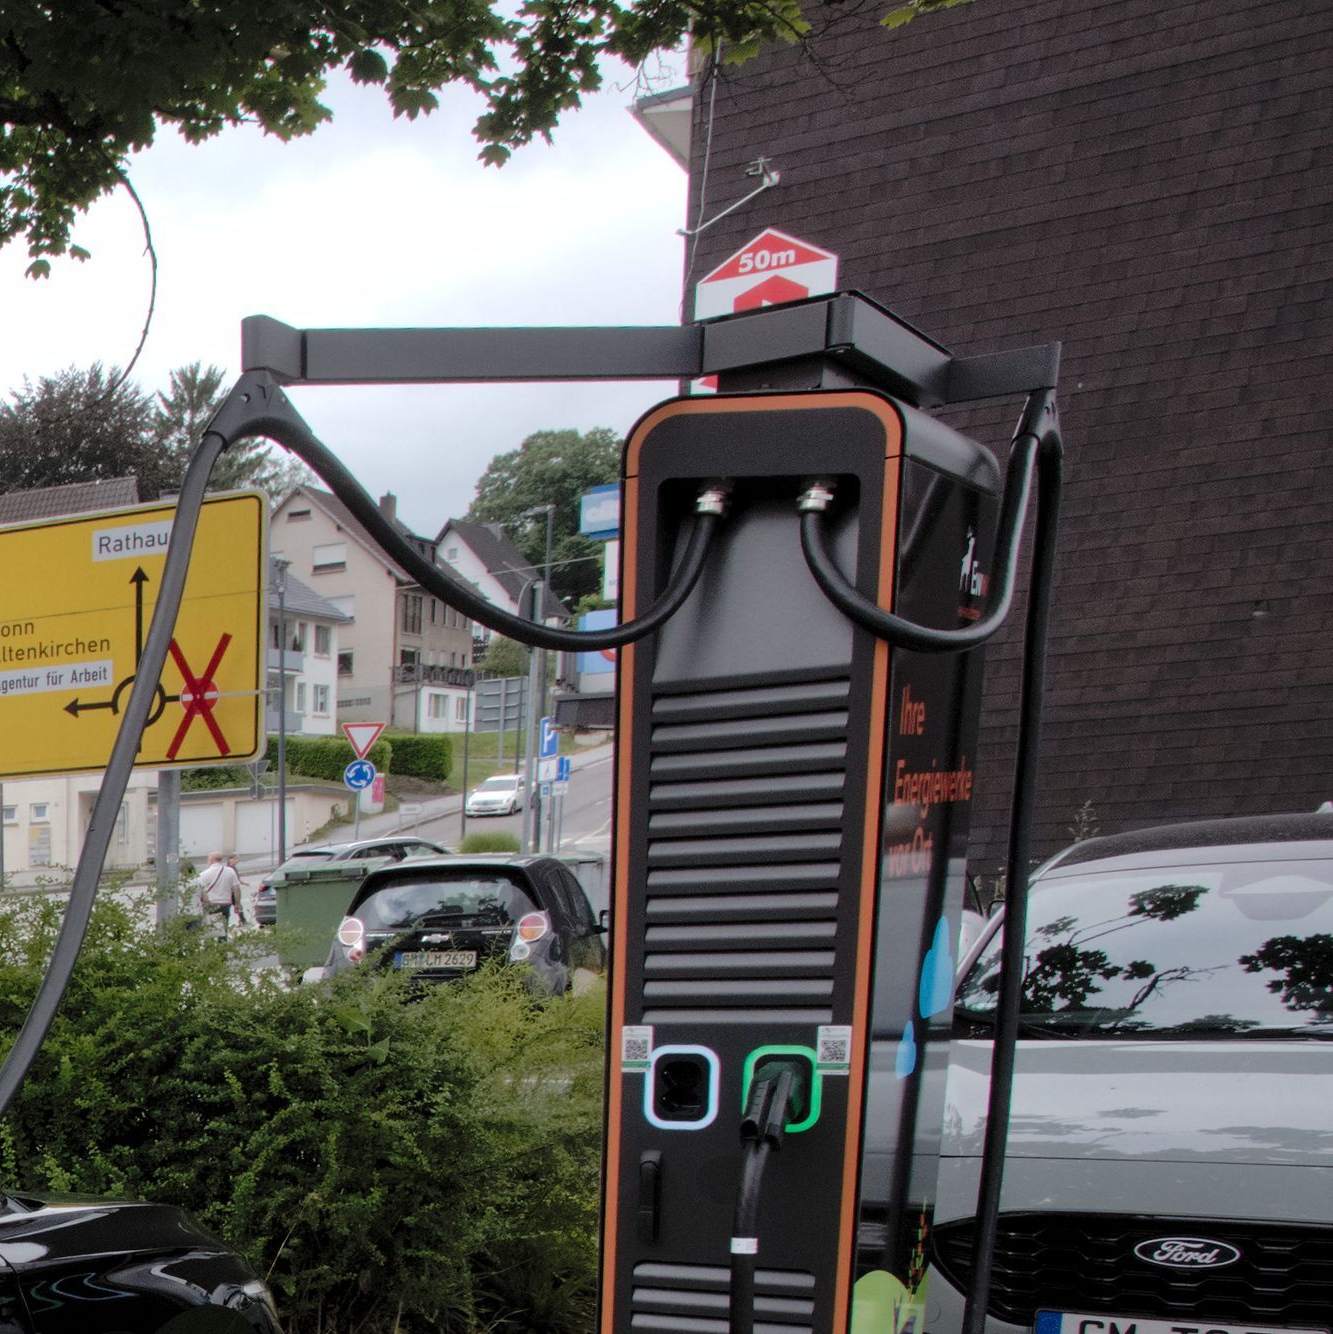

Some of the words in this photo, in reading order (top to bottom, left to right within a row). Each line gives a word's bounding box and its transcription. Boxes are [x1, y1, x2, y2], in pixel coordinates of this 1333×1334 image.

[738, 249, 795, 273] 50m
[98, 532, 170, 554] Rathau
[46, 671, 64, 687] für
[70, 666, 108, 684] Arbeit
[899, 683, 926, 735] Ihre
[444, 953, 474, 966] 2629
[1153, 1241, 1221, 1264] Ford
